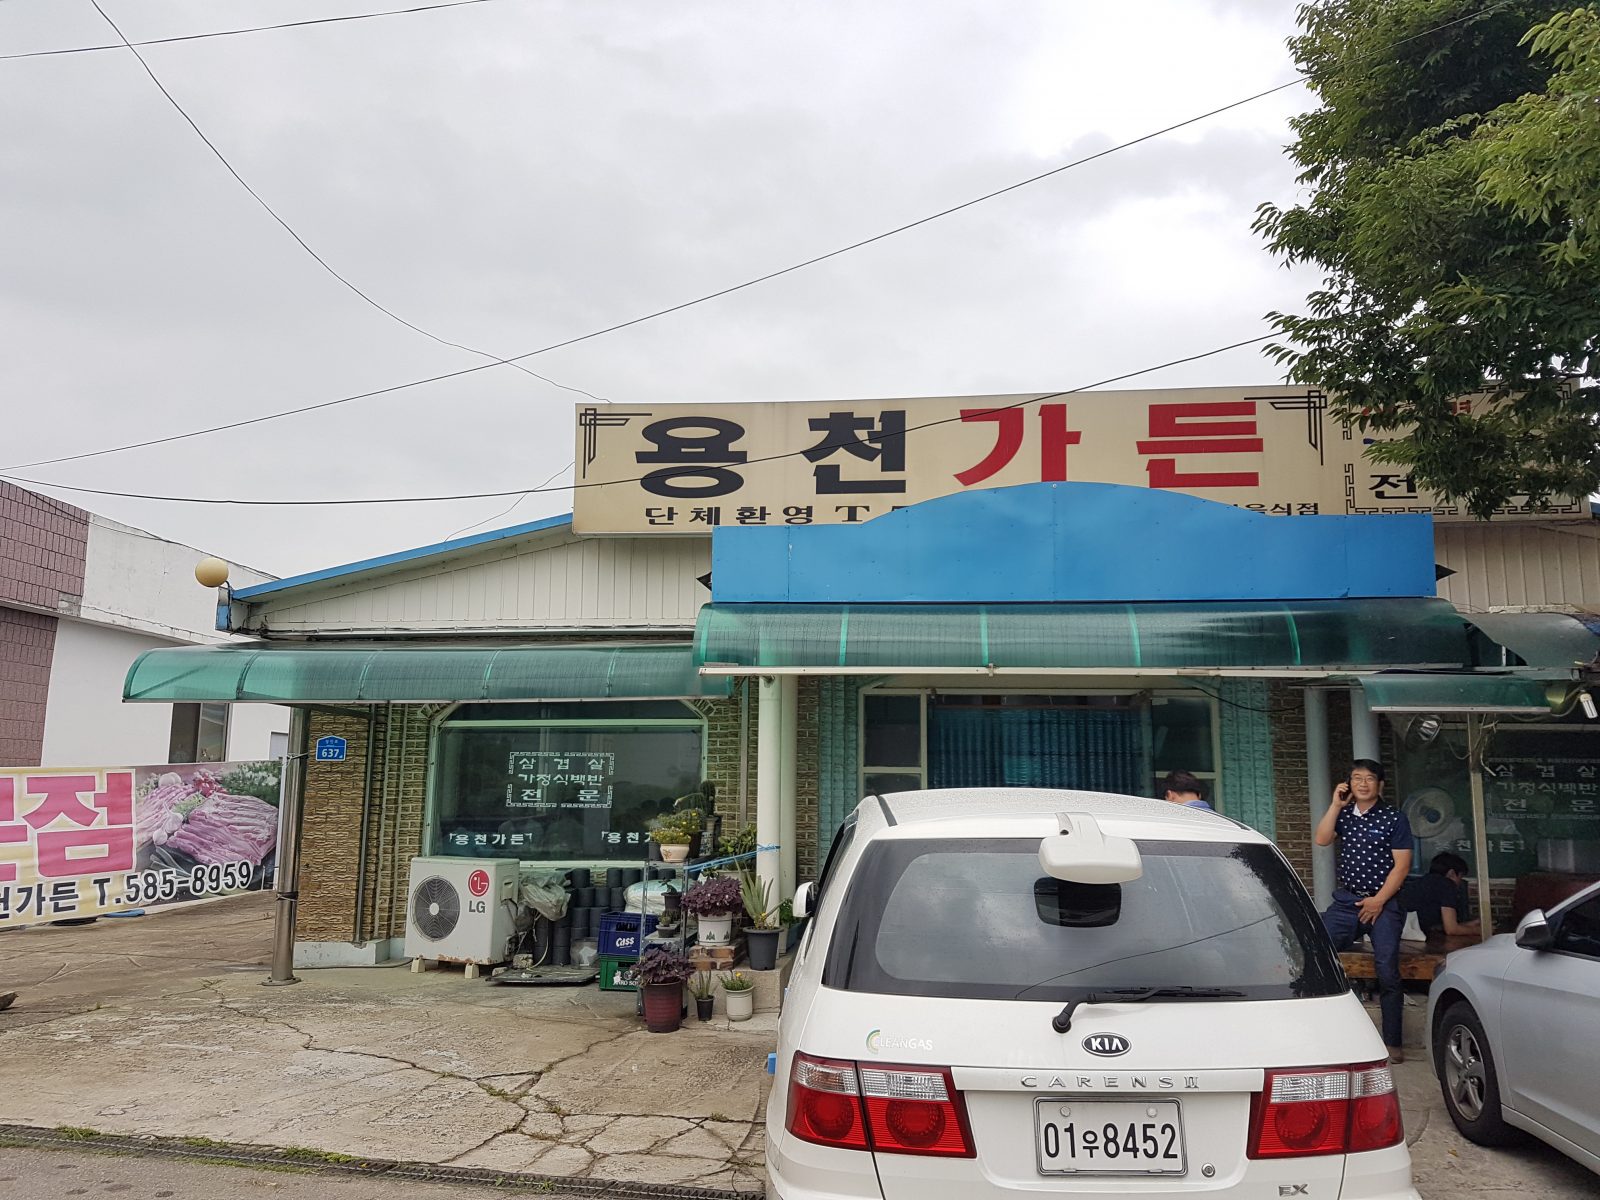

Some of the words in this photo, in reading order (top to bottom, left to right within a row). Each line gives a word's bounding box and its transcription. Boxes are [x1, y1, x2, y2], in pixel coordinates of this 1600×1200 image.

[645, 505, 813, 526] 단체환영
[321, 748, 340, 758] 637
[518, 774, 605, 786] 가정식백반
[0, 772, 133, 881] 점
[469, 900, 486, 913] LG
[1090, 1037, 1123, 1051] KIA
[1044, 1122, 1178, 1159] 01우8452
[1279, 1184, 1309, 1197] EX
